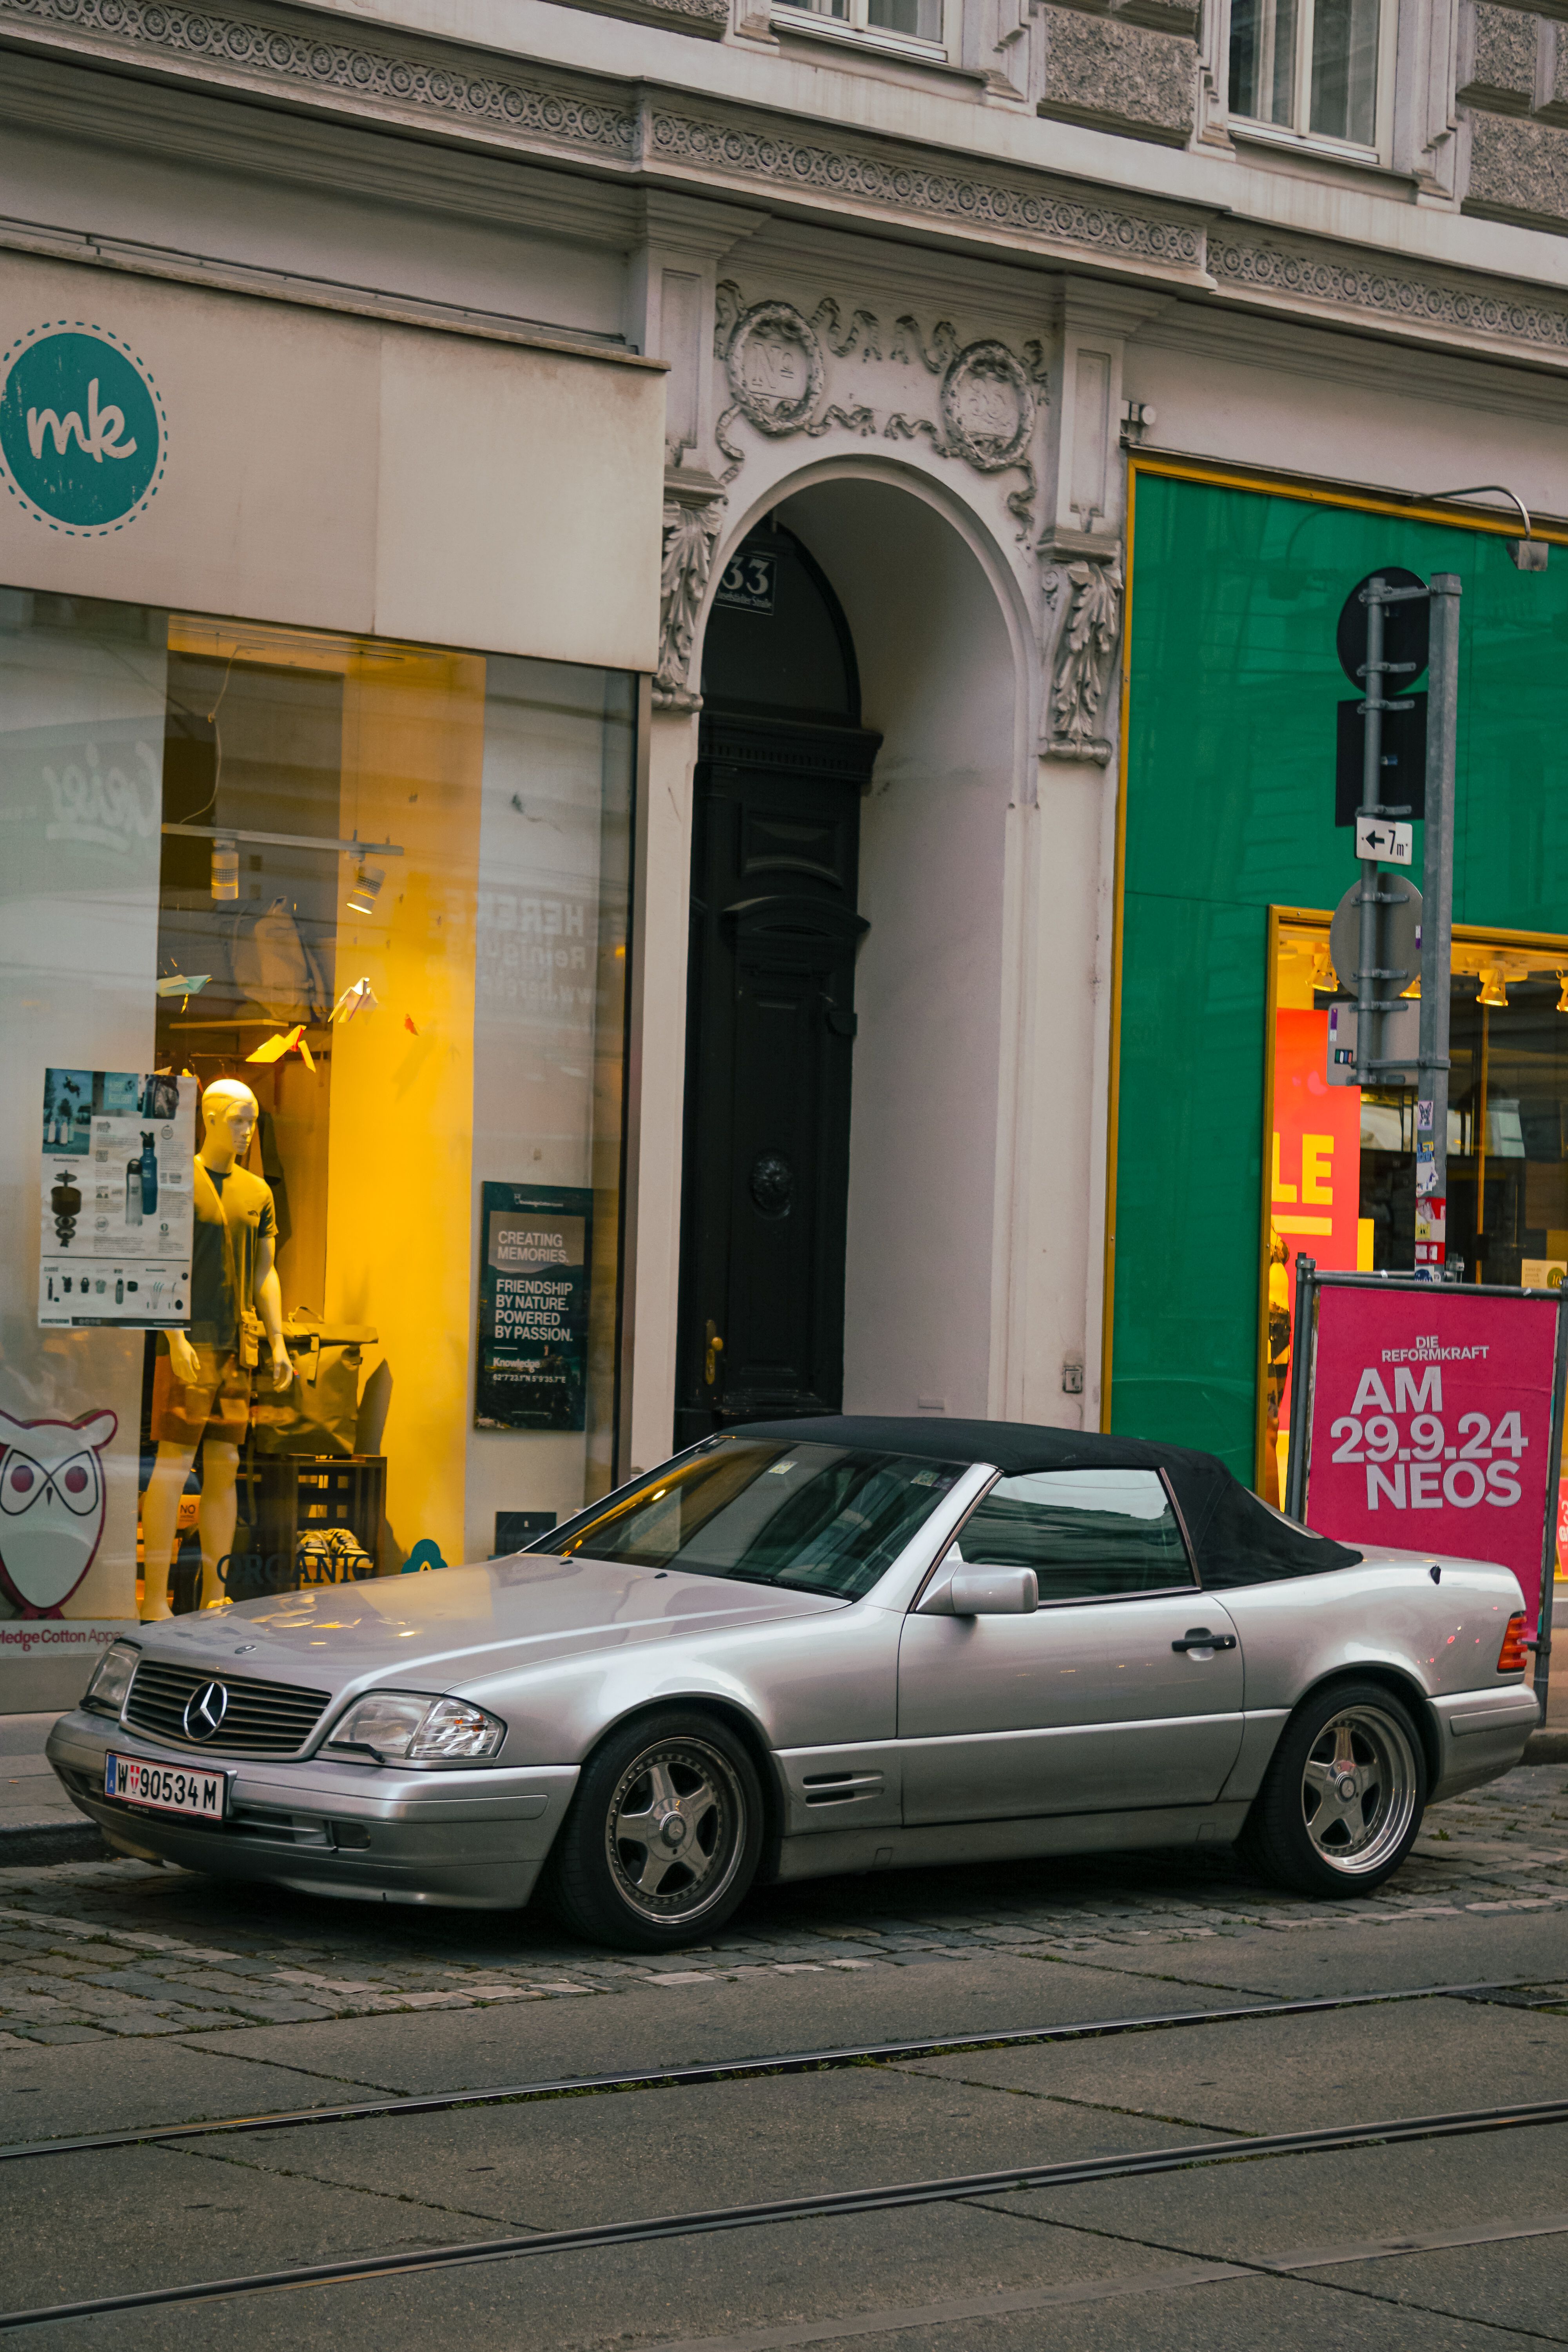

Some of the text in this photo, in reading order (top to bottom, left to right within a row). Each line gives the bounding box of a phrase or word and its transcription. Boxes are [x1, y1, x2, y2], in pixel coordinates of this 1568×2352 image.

[27, 377, 137, 463] mk
[722, 555, 769, 595] 33
[1271, 1132, 1334, 1205] LE
[498, 1231, 563, 1247] CREATING
[497, 1246, 569, 1263] MEMORIES.
[497, 1279, 573, 1295] FRIENDSHIP
[496, 1295, 569, 1311] BY NATURE.
[496, 1310, 560, 1326] POWERED
[495, 1325, 573, 1342] BY PASSION.
[1416, 1336, 1439, 1349] DIE
[1382, 1346, 1489, 1362] REFORMKRAFT
[1350, 1366, 1443, 1415] AM
[1331, 1411, 1528, 1463] 29.9.24
[1367, 1460, 1521, 1510] NEOS
[140, 1768, 198, 1806] 90534
